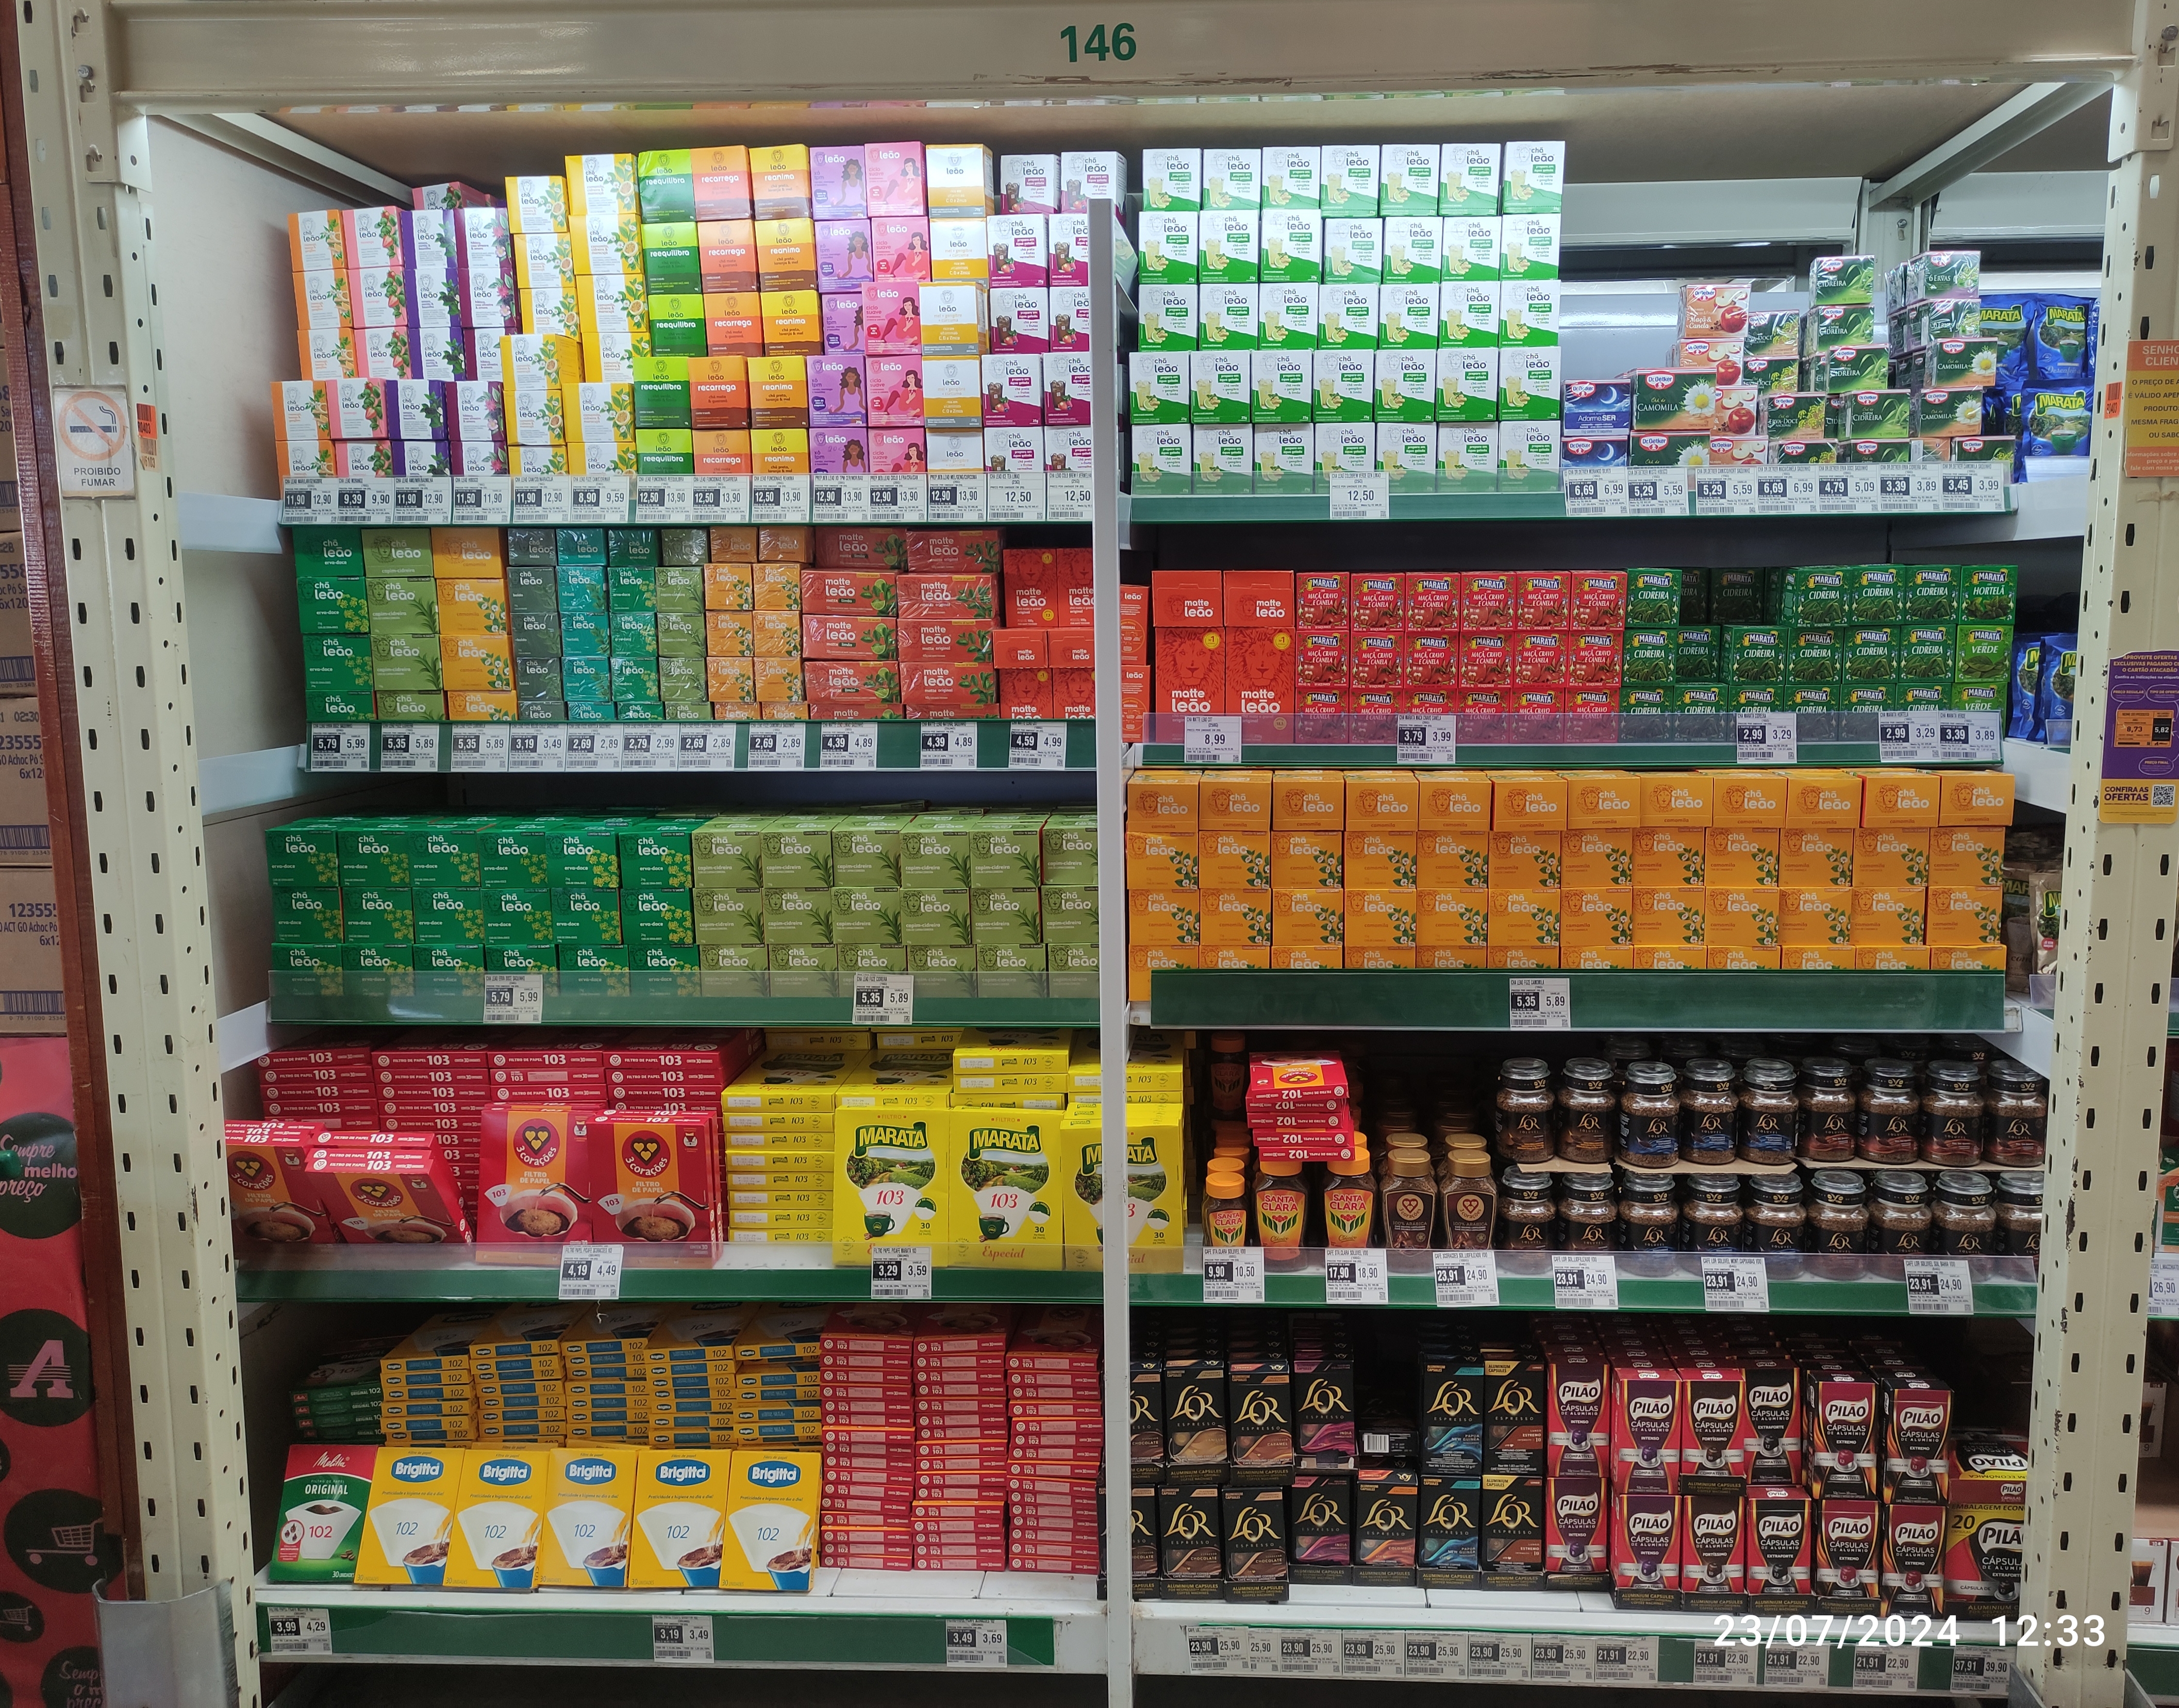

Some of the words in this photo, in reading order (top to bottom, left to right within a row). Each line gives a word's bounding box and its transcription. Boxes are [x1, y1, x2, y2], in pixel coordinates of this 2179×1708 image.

[1061, 23, 1136, 62] 146
[1531, 154, 1554, 162] leão
[701, 174, 739, 184] recarrega
[764, 173, 794, 181] reanima
[650, 249, 690, 258] reequilibra
[1689, 316, 1705, 324] Maçã
[1637, 403, 1678, 411] CAMOMILA
[1575, 485, 1594, 497] 6,69
[1604, 485, 1623, 496] 6,99
[1825, 482, 1844, 493] 4,79
[1855, 482, 1874, 492] 5,09
[286, 494, 305, 506] 11,90
[313, 494, 331, 505] 12,90
[344, 494, 362, 506] 9,39
[372, 494, 390, 505] 9,90
[456, 493, 476, 505] 11,50
[578, 492, 596, 504] 8,90
[606, 492, 624, 504] 9,59
[816, 491, 835, 503] 12,90
[843, 491, 862, 503] 13,90
[1347, 490, 1374, 503] 12,50
[825, 578, 850, 587] matte
[314, 589, 343, 600] leão
[825, 586, 855, 597] leão
[1638, 591, 1669, 600] CIDREIRA
[1973, 585, 2005, 595] HORTELÃ
[1185, 606, 1213, 617] leão
[1172, 689, 1205, 699] matte
[1172, 699, 1210, 712] leão
[1205, 734, 1225, 745] 8,99
[1404, 731, 1423, 742] 3,79
[1433, 732, 1451, 743] 3,99
[1743, 729, 1763, 740] 2,99
[1773, 729, 1792, 740] 3,29
[1975, 730, 1994, 741] 3,89
[318, 738, 337, 750] 5,79
[346, 738, 365, 749] 5,99
[515, 738, 534, 749] 3,19
[543, 739, 561, 749] 3,49
[1017, 735, 1035, 747] 4,59
[1044, 737, 1062, 748] 4,99
[8, 754, 28, 765] Achoc
[1972, 795, 2004, 807] leão
[491, 991, 510, 1004] 5,79
[519, 991, 538, 1003] 5,99
[1516, 996, 1536, 1009] 5,35
[1545, 995, 1565, 1008] 5,89
[543, 1054, 566, 1066] 103
[1282, 1090, 1302, 1099] 102
[860, 1127, 927, 1149] MARATÁ
[876, 1189, 904, 1206] 103
[1264, 1195, 1294, 1203] SANTA
[1261, 1202, 1298, 1212] CLARA
[983, 1246, 1025, 1262] Especial
[568, 1264, 588, 1279] 4,19
[597, 1264, 617, 1279] 4,49
[878, 1265, 899, 1278] 3,29
[907, 1265, 927, 1278] 3,59
[1208, 1266, 1225, 1278] 9,90
[1235, 1267, 1255, 1278] 10,50
[1328, 1267, 1349, 1279] 17,90
[1358, 1268, 1378, 1279] 18,90
[1556, 1273, 1577, 1286] 23,91
[1586, 1274, 1607, 1286] 24,90
[2154, 1280, 2175, 1296] 26,90
[1633, 1401, 1670, 1415] PILÃO
[1631, 1420, 1670, 1429] CÁPSULAS
[317, 1453, 346, 1469] Melitta
[395, 1463, 440, 1479] Brigitta
[305, 1482, 348, 1496] ORIGINAL
[395, 1521, 418, 1536] 102
[1951, 1516, 1975, 1530] 20
[309, 1525, 332, 1539] 102
[277, 1622, 296, 1633] 3,99
[307, 1621, 325, 1633] 4,29
[953, 1633, 972, 1644] 3,49
[983, 1633, 1002, 1645] 3,69
[1190, 1641, 1211, 1652] 23,90
[1220, 1640, 1240, 1651] 25,90
[1955, 1660, 1977, 1671] 37,91
[1986, 1662, 2007, 1673] 39,90
